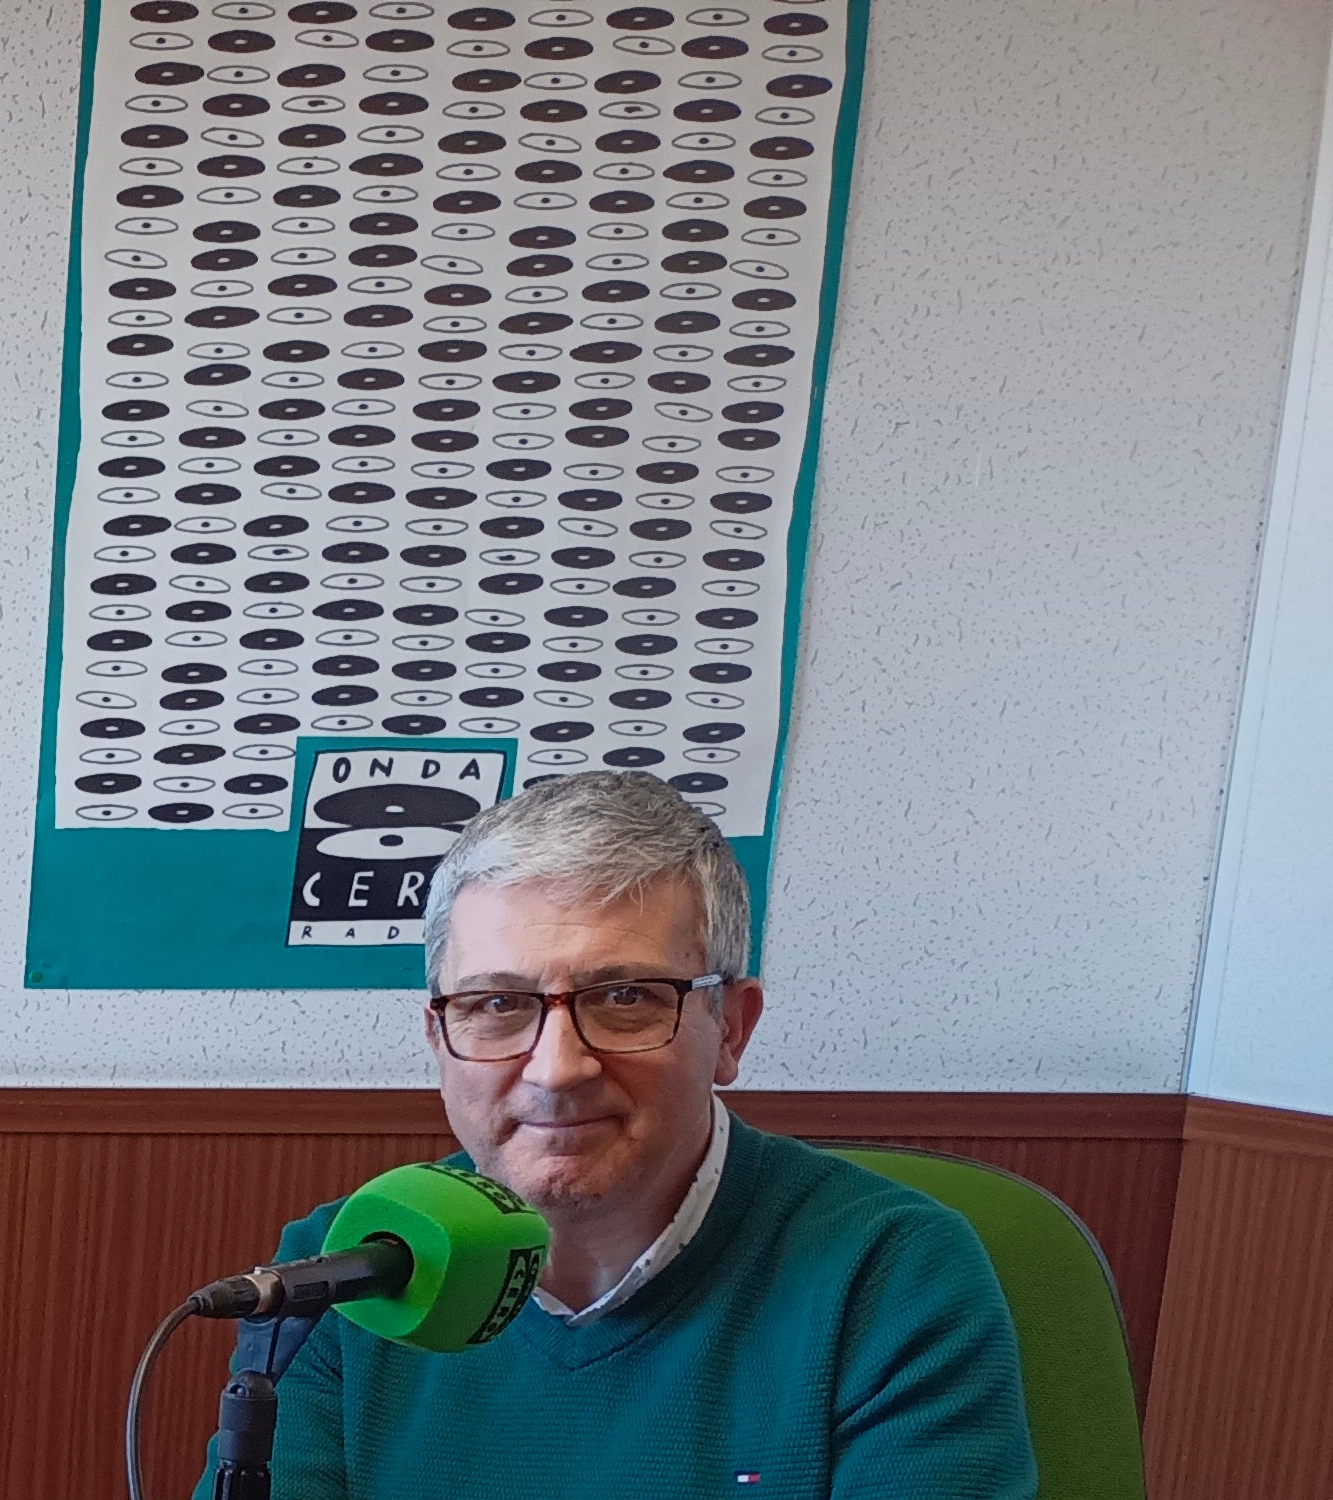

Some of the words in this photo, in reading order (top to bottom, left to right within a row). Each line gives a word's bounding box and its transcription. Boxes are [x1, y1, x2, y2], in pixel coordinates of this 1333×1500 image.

[332, 756, 481, 783] ONDA
[302, 871, 425, 907] CER
[301, 926, 425, 939] RAD
